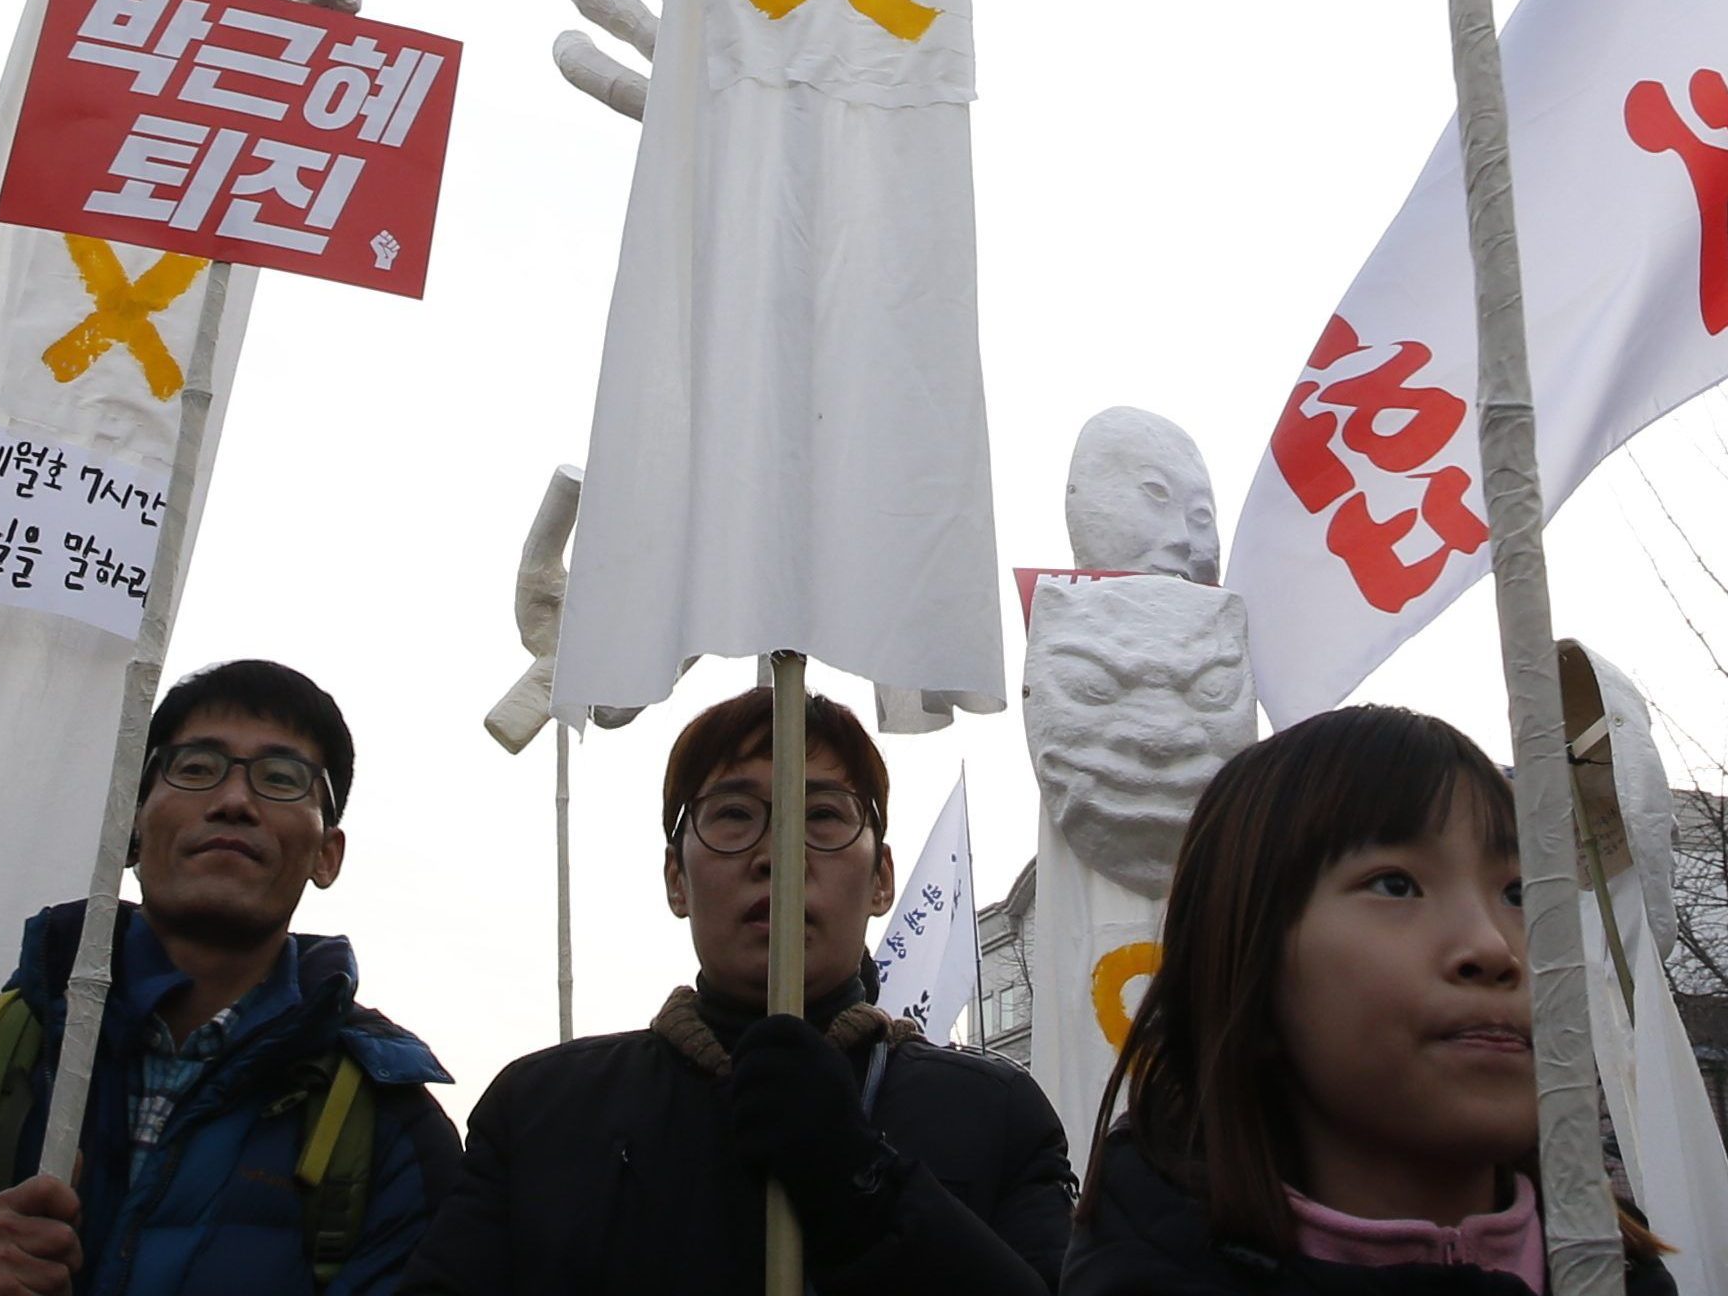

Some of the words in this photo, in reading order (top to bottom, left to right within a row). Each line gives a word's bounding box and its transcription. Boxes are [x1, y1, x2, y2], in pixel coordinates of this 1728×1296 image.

[82, 114, 366, 256] 퇴진
[80, 465, 167, 527] 7시간
[64, 532, 151, 608] 말하라
